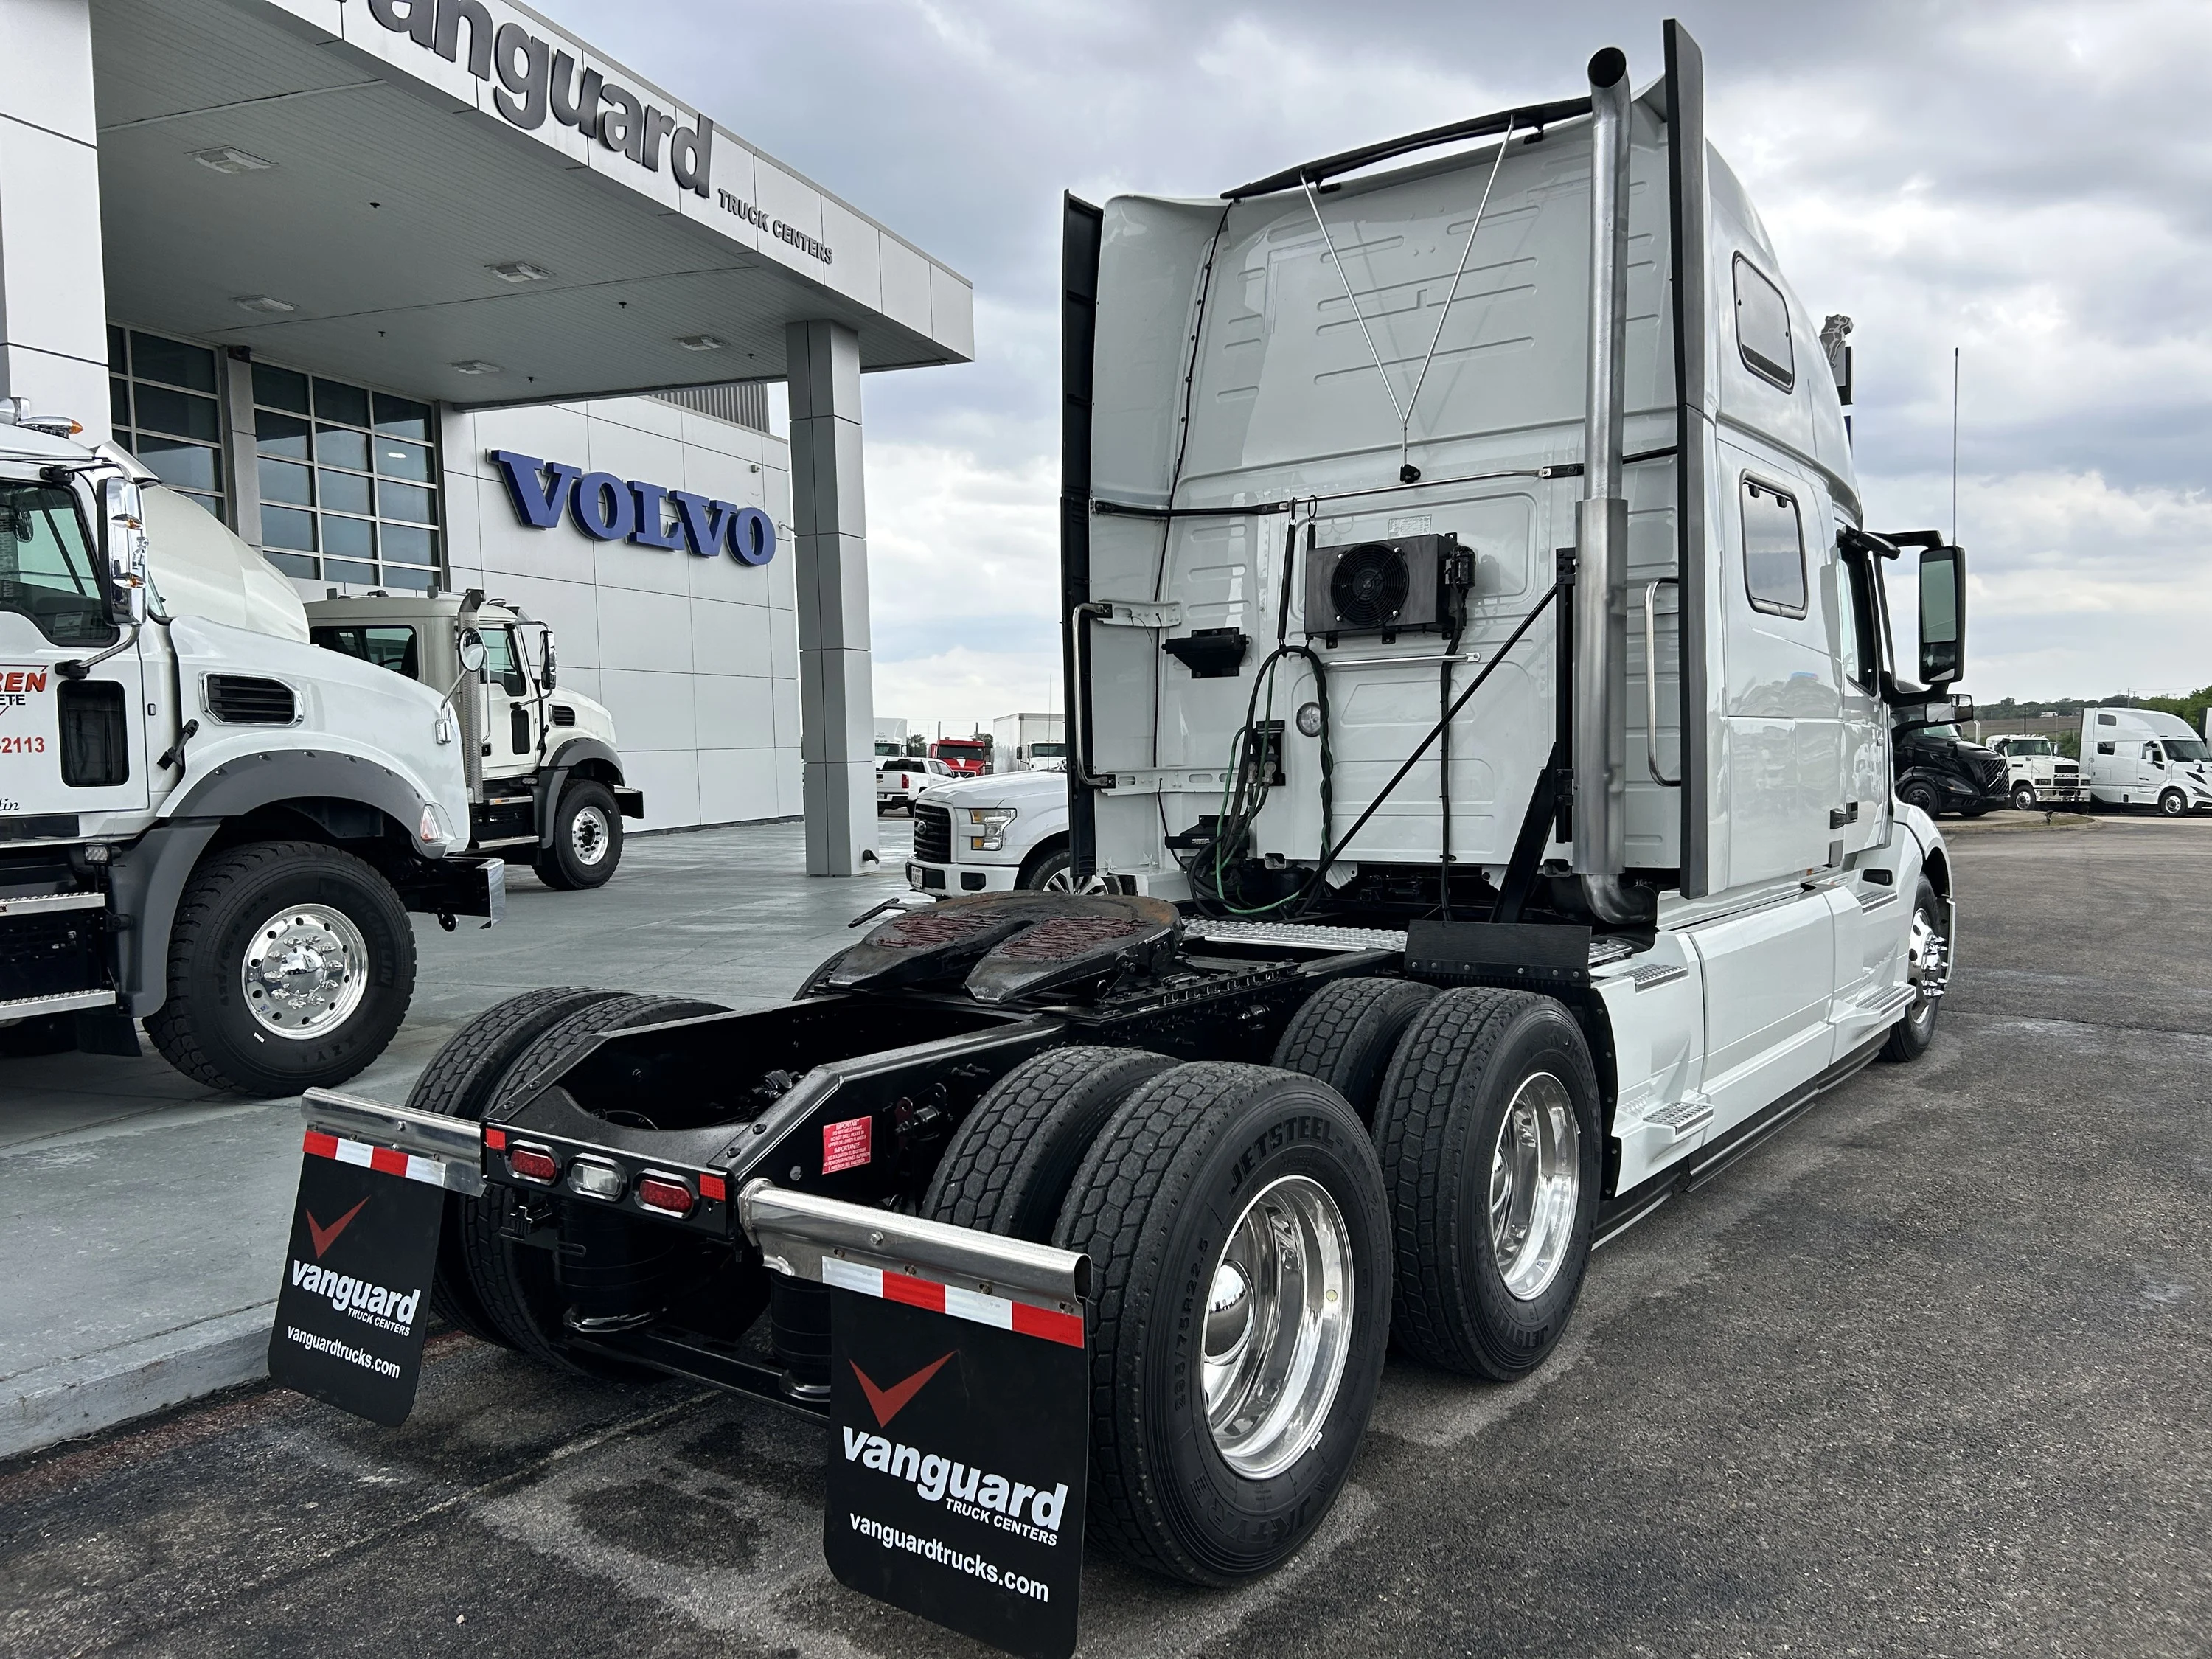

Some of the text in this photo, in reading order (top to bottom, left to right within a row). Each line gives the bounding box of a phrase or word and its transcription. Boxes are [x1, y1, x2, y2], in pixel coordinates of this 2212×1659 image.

[336, 0, 714, 198] anguard
[718, 188, 833, 265] TRUCK CENTERS
[485, 449, 776, 566] VOLVO
[0, 672, 47, 692] EN
[0, 737, 45, 754] 2113
[834, 1142, 860, 1153] IMPORTANTE
[836, 1120, 859, 1130] IMPORTANT
[292, 1259, 420, 1325] vanguard
[348, 1307, 411, 1337] TRUCK CENTERS
[287, 1325, 400, 1379] vanguardtrucks.com
[843, 1425, 1069, 1531] vanguard
[945, 1498, 1058, 1547] TRUCK CENTERS
[849, 1512, 1049, 1603] vanguardtrucks.com
